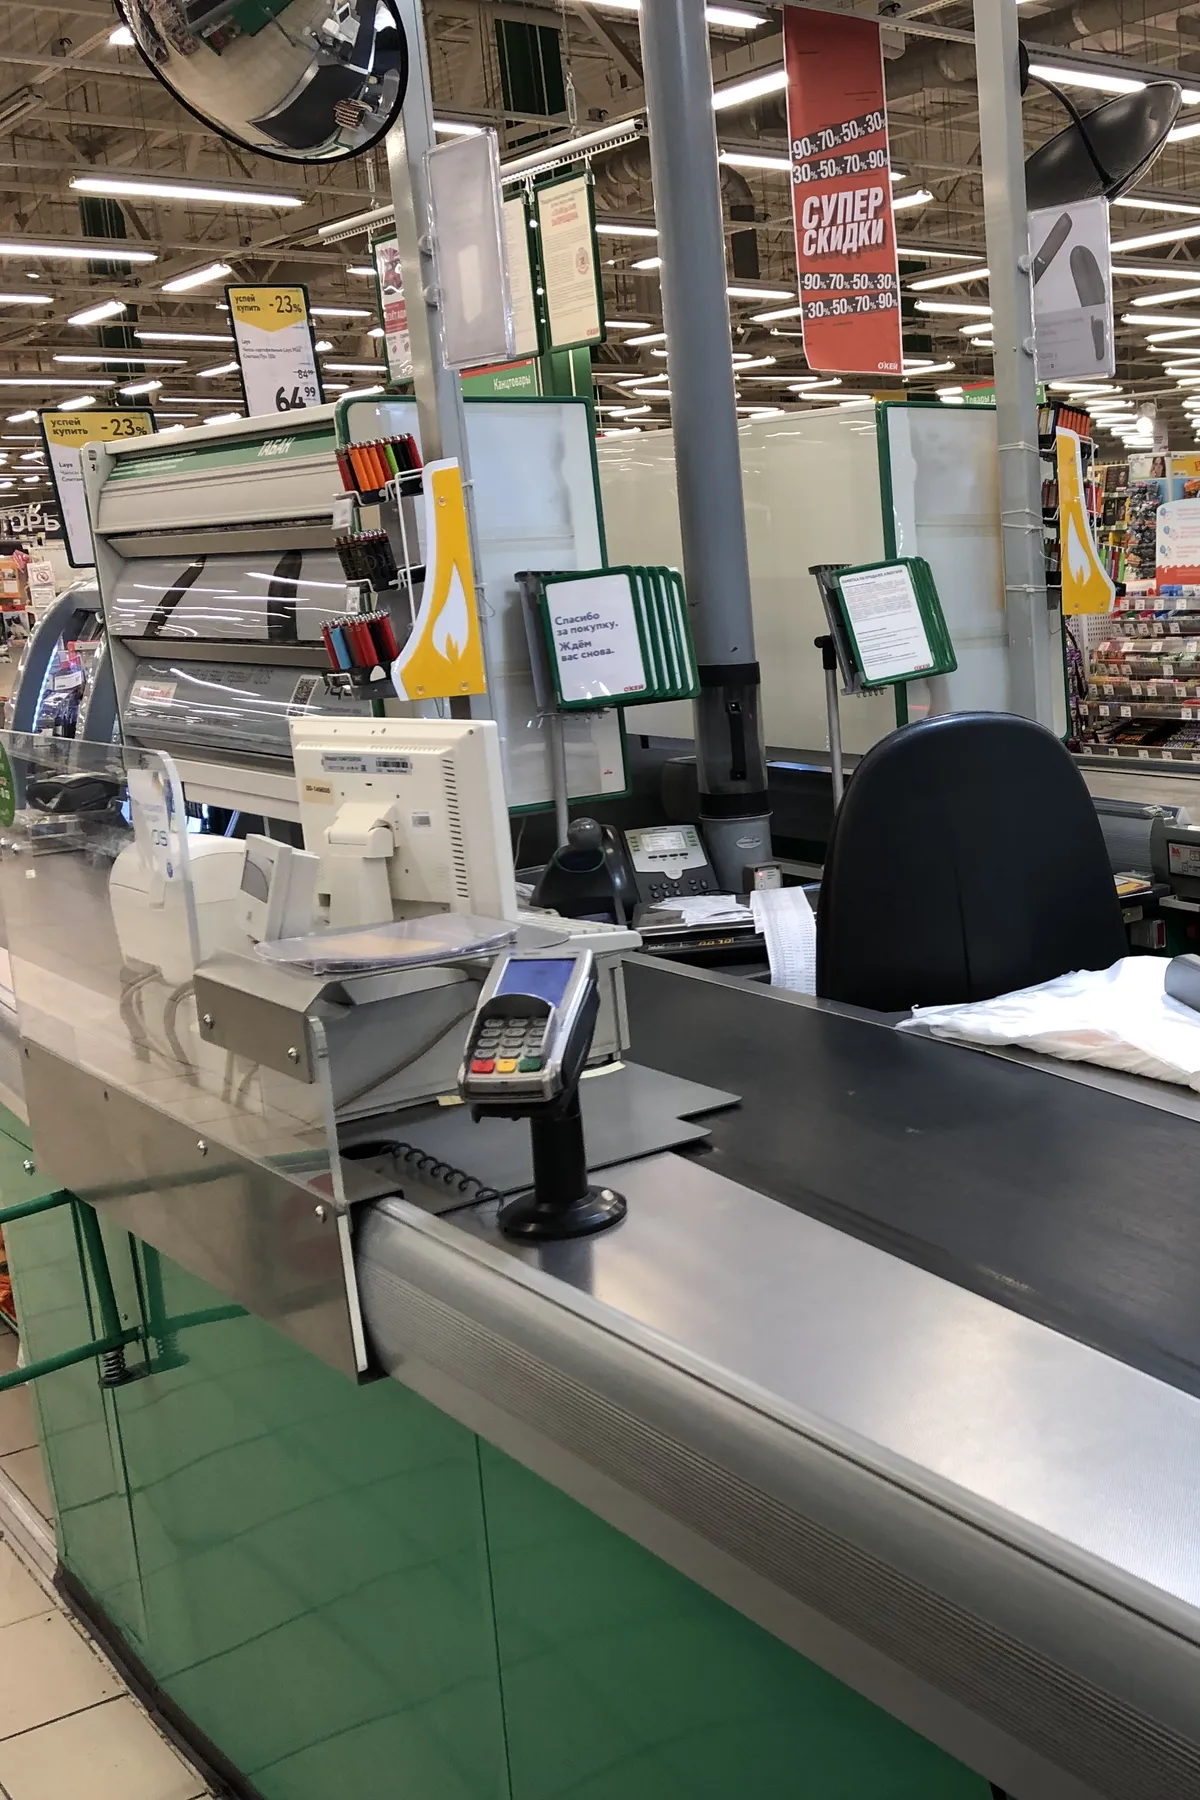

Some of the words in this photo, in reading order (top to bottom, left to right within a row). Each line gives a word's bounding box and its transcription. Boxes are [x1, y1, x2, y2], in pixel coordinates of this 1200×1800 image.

[816, 129, 842, 151] -70%
[840, 120, 866, 142] -50%
[817, 159, 843, 179] -50%
[842, 154, 867, 173] -70%
[802, 187, 884, 230] СУПЕР
[803, 218, 884, 256] СКИДКИ
[801, 273, 826, 290] -90%
[826, 273, 850, 290] -70%
[850, 273, 874, 289] -50%
[874, 273, 897, 289] -30%
[235, 293, 256, 304] успей
[269, 295, 302, 313] -23%
[804, 301, 830, 319] -30%
[830, 298, 853, 315] -50%
[852, 295, 876, 312] -70%
[876, 292, 898, 309] -90%
[237, 304, 260, 313] купить
[493, 375, 532, 391] Канцтовары
[275, 386, 306, 412] 64
[304, 386, 316, 397] 99
[50, 417, 81, 428] успей
[101, 418, 148, 436] -23%
[53, 428, 89, 436] купить
[257, 437, 297, 457] ТАБАК
[555, 611, 600, 626] Спасибо
[557, 628, 568, 636] за
[570, 621, 619, 635] покупку.
[558, 640, 592, 652] Ждём
[561, 653, 579, 662] вас
[581, 648, 615, 659] снова.
